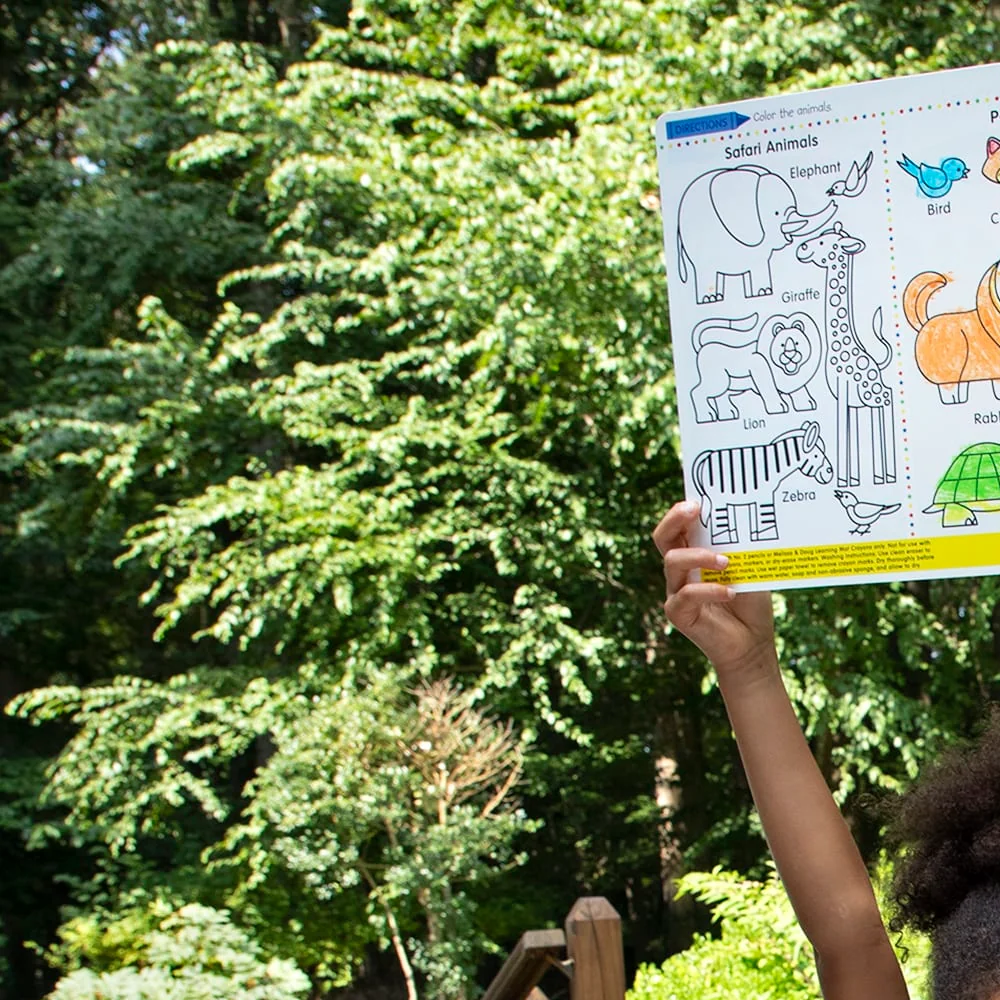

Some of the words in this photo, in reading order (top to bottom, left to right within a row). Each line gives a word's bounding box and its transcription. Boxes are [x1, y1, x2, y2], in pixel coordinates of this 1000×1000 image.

[753, 111, 776, 122] Color
[780, 107, 794, 118] the
[797, 101, 832, 115] animals
[675, 117, 728, 135] DIRECTIONS
[725, 142, 761, 159] Safari
[766, 134, 819, 153] Animals
[790, 161, 841, 180] Elephant
[927, 202, 951, 216] Bird
[781, 288, 821, 303] Giraffe
[743, 418, 766, 431] Lion
[781, 489, 816, 503] Zebra
